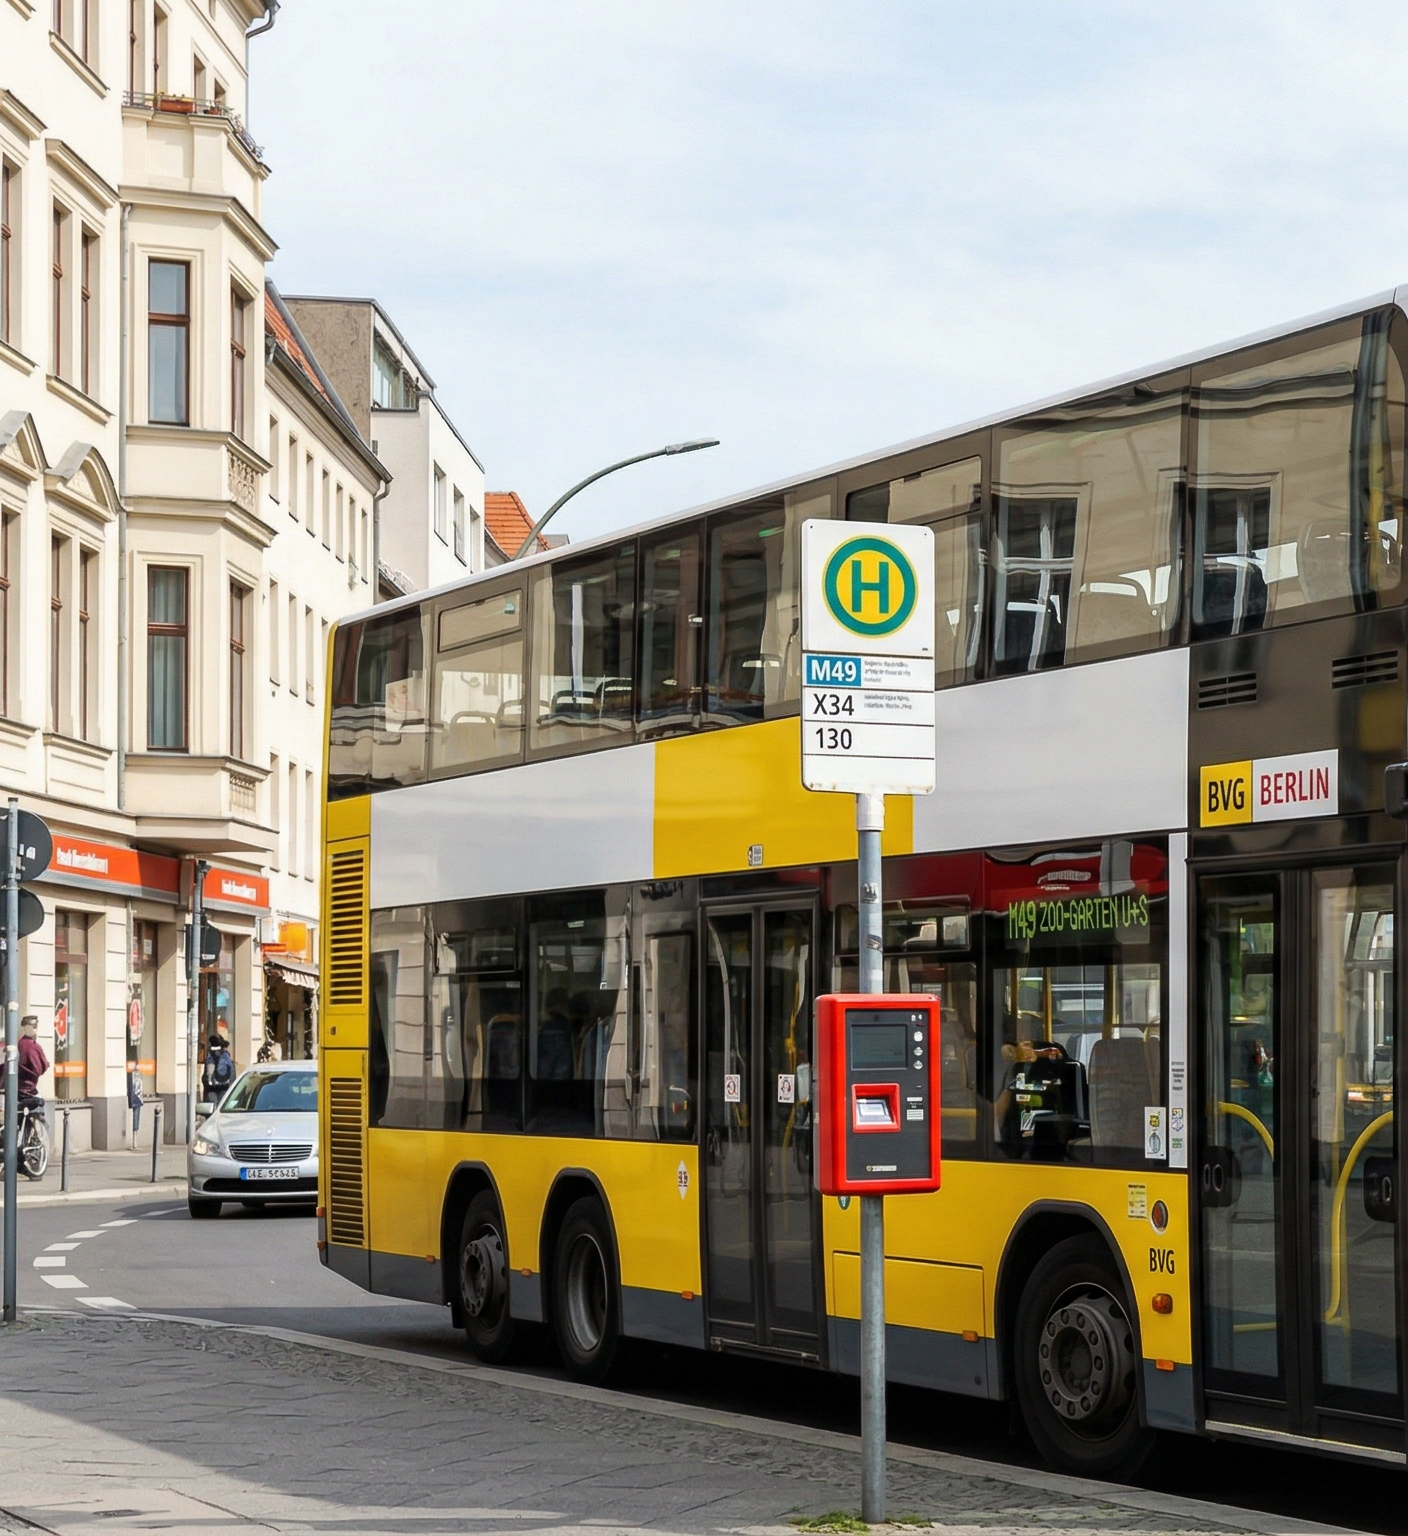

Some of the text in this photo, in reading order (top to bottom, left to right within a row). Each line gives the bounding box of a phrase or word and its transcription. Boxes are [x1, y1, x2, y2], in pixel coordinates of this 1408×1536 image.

[851, 560, 890, 614] H
[811, 658, 858, 683] M49
[812, 693, 855, 717] X34
[815, 727, 853, 750] 130
[1208, 767, 1329, 812] BVG BERLIN
[1009, 894, 1148, 939] M49 ZOO-GARTEN U+S
[1149, 1248, 1174, 1274] BVG
